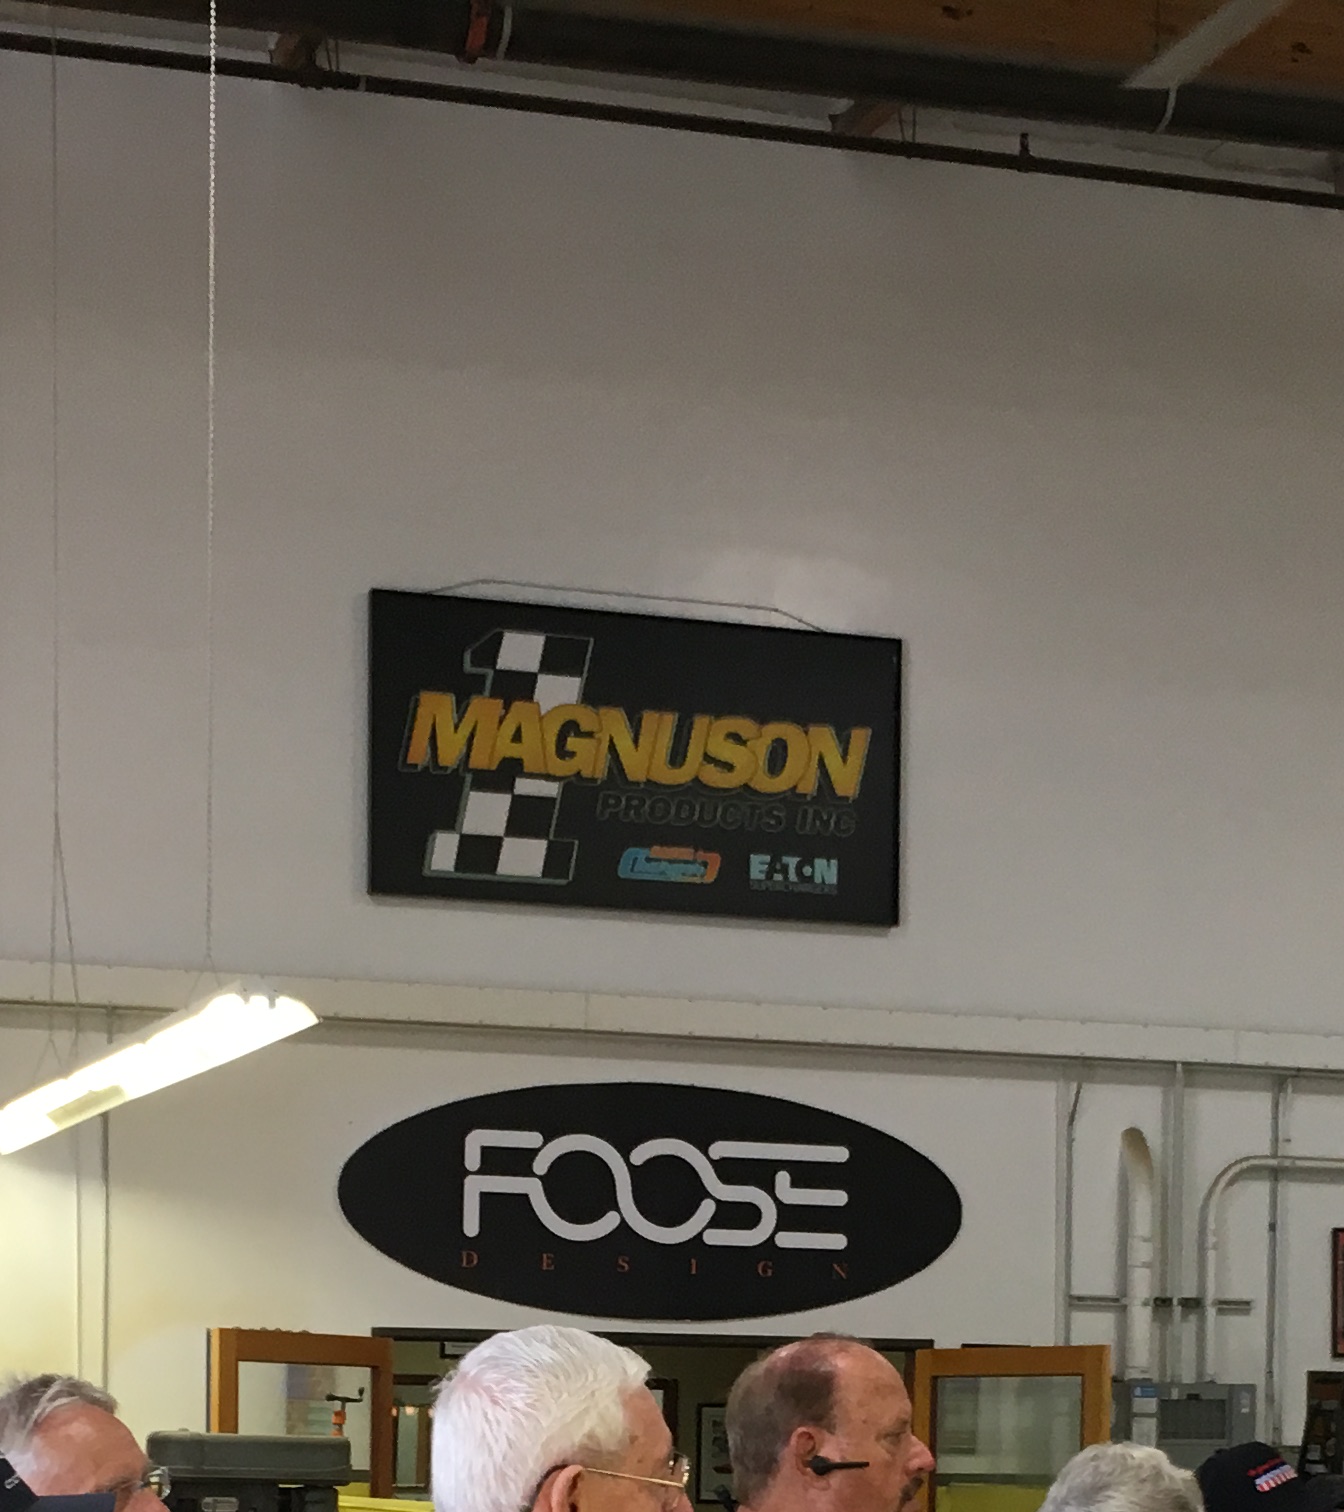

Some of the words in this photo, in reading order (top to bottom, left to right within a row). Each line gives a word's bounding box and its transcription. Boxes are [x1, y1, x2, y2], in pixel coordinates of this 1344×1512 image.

[402, 690, 871, 801] MAGNUSON
[596, 790, 786, 834] PRODUCTS
[795, 804, 860, 838] INC
[749, 853, 839, 885] EATON
[462, 1129, 850, 1250] FOOSE
[460, 1249, 850, 1280] DESIGN
